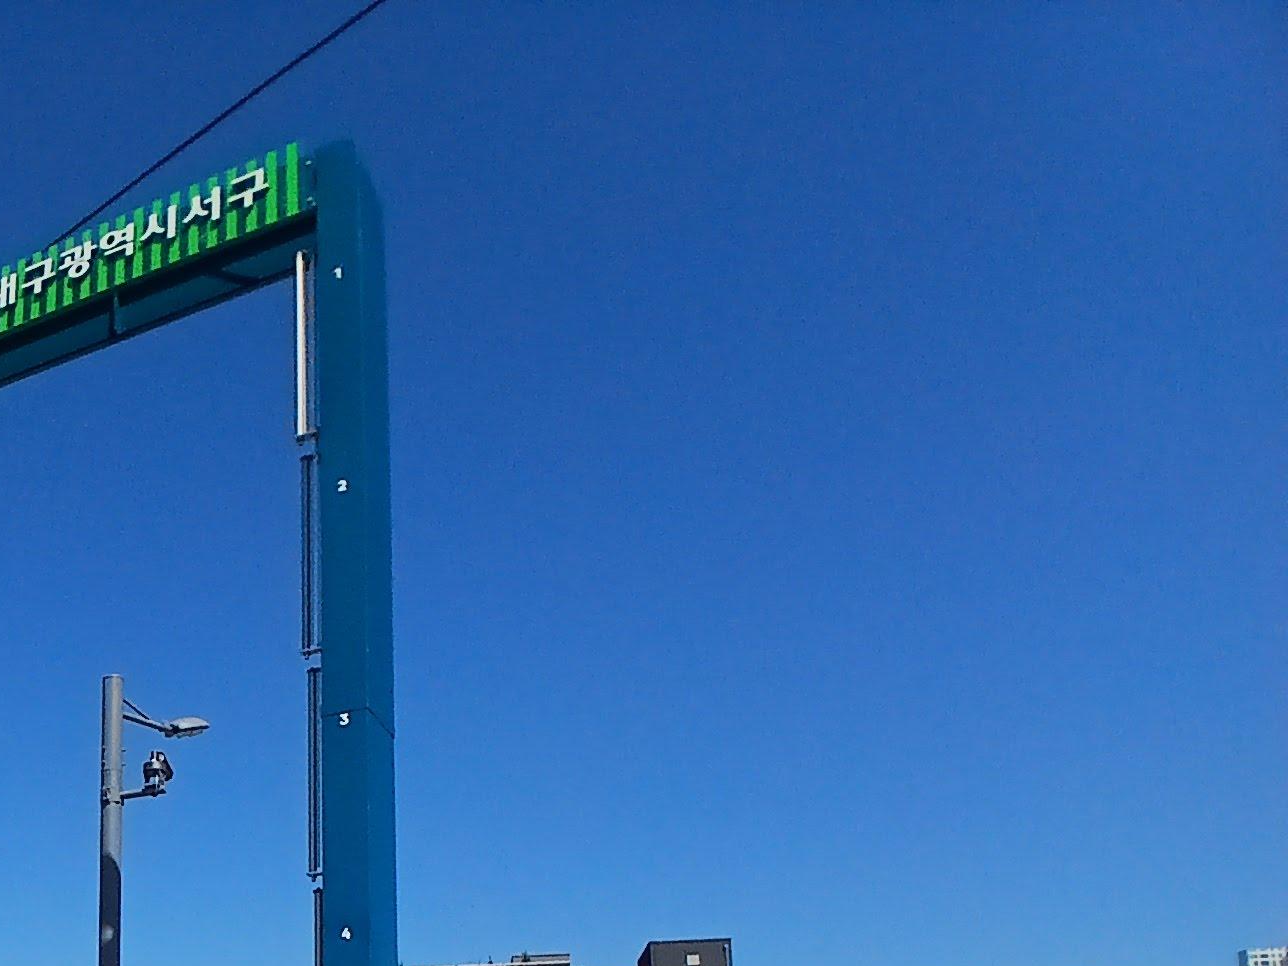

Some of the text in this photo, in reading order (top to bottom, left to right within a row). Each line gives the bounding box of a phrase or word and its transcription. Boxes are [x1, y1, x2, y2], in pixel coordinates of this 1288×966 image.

[333, 267, 342, 280] 1
[337, 479, 347, 492] 2
[339, 712, 350, 726] 3
[341, 927, 351, 940] 4
